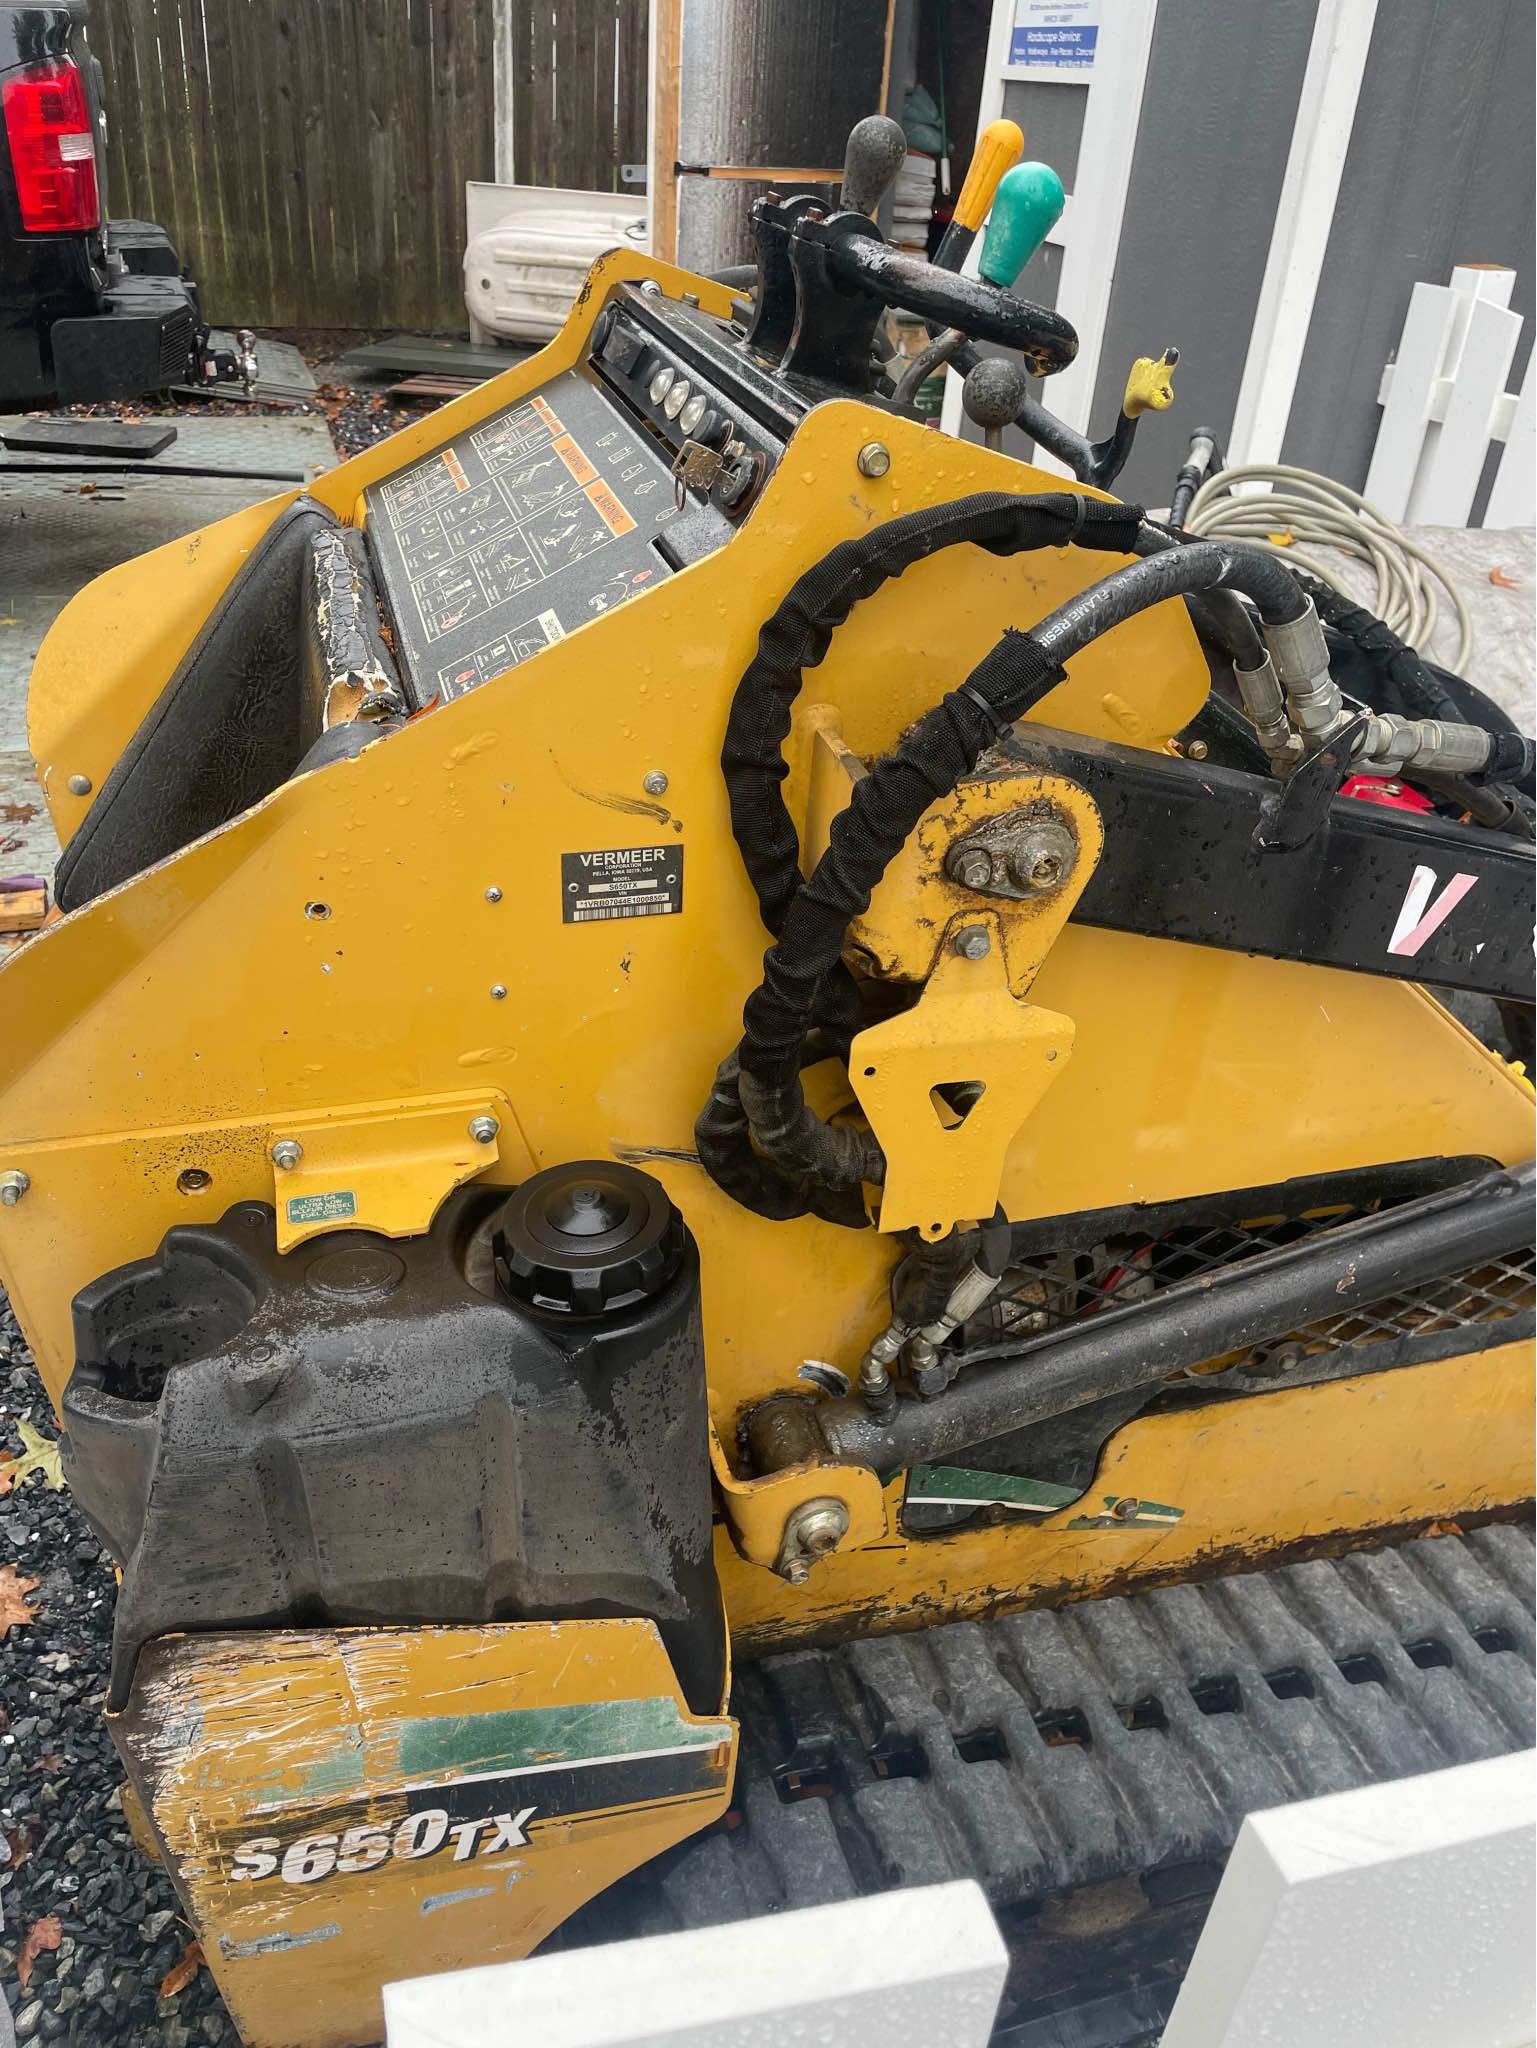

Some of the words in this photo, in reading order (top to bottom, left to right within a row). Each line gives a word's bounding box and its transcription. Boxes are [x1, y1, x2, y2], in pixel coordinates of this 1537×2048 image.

[580, 848, 666, 867] VERMEER
[604, 862, 642, 870] CORPORATION
[608, 882, 638, 891] S650TX
[298, 1202, 324, 1210] ULTRA
[231, 1806, 538, 1884] S650TX
